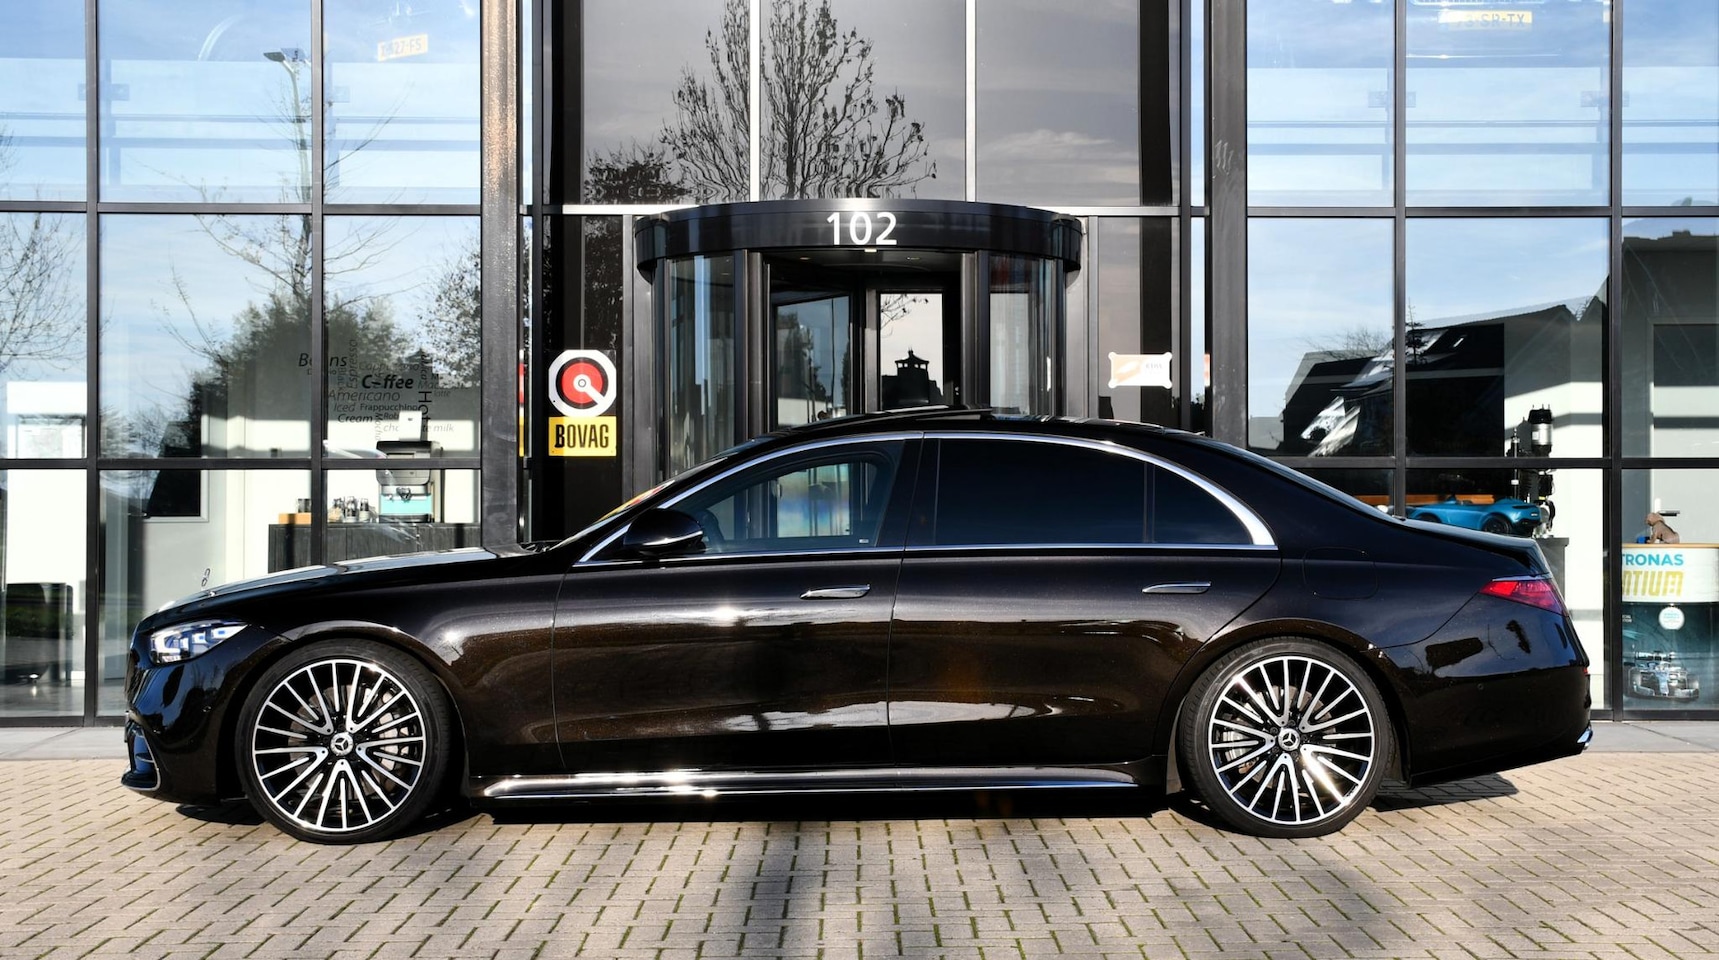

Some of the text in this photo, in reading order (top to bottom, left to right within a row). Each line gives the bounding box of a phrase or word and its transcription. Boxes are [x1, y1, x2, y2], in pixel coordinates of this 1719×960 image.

[827, 211, 897, 246] 102
[298, 353, 347, 367] Bns
[361, 374, 414, 389] Cffee
[328, 389, 400, 402] Americano
[333, 402, 355, 412] Iced
[337, 413, 373, 423] Cream
[433, 423, 455, 432] milk
[554, 424, 609, 449] BOVAG
[1622, 553, 1684, 566] RONAS
